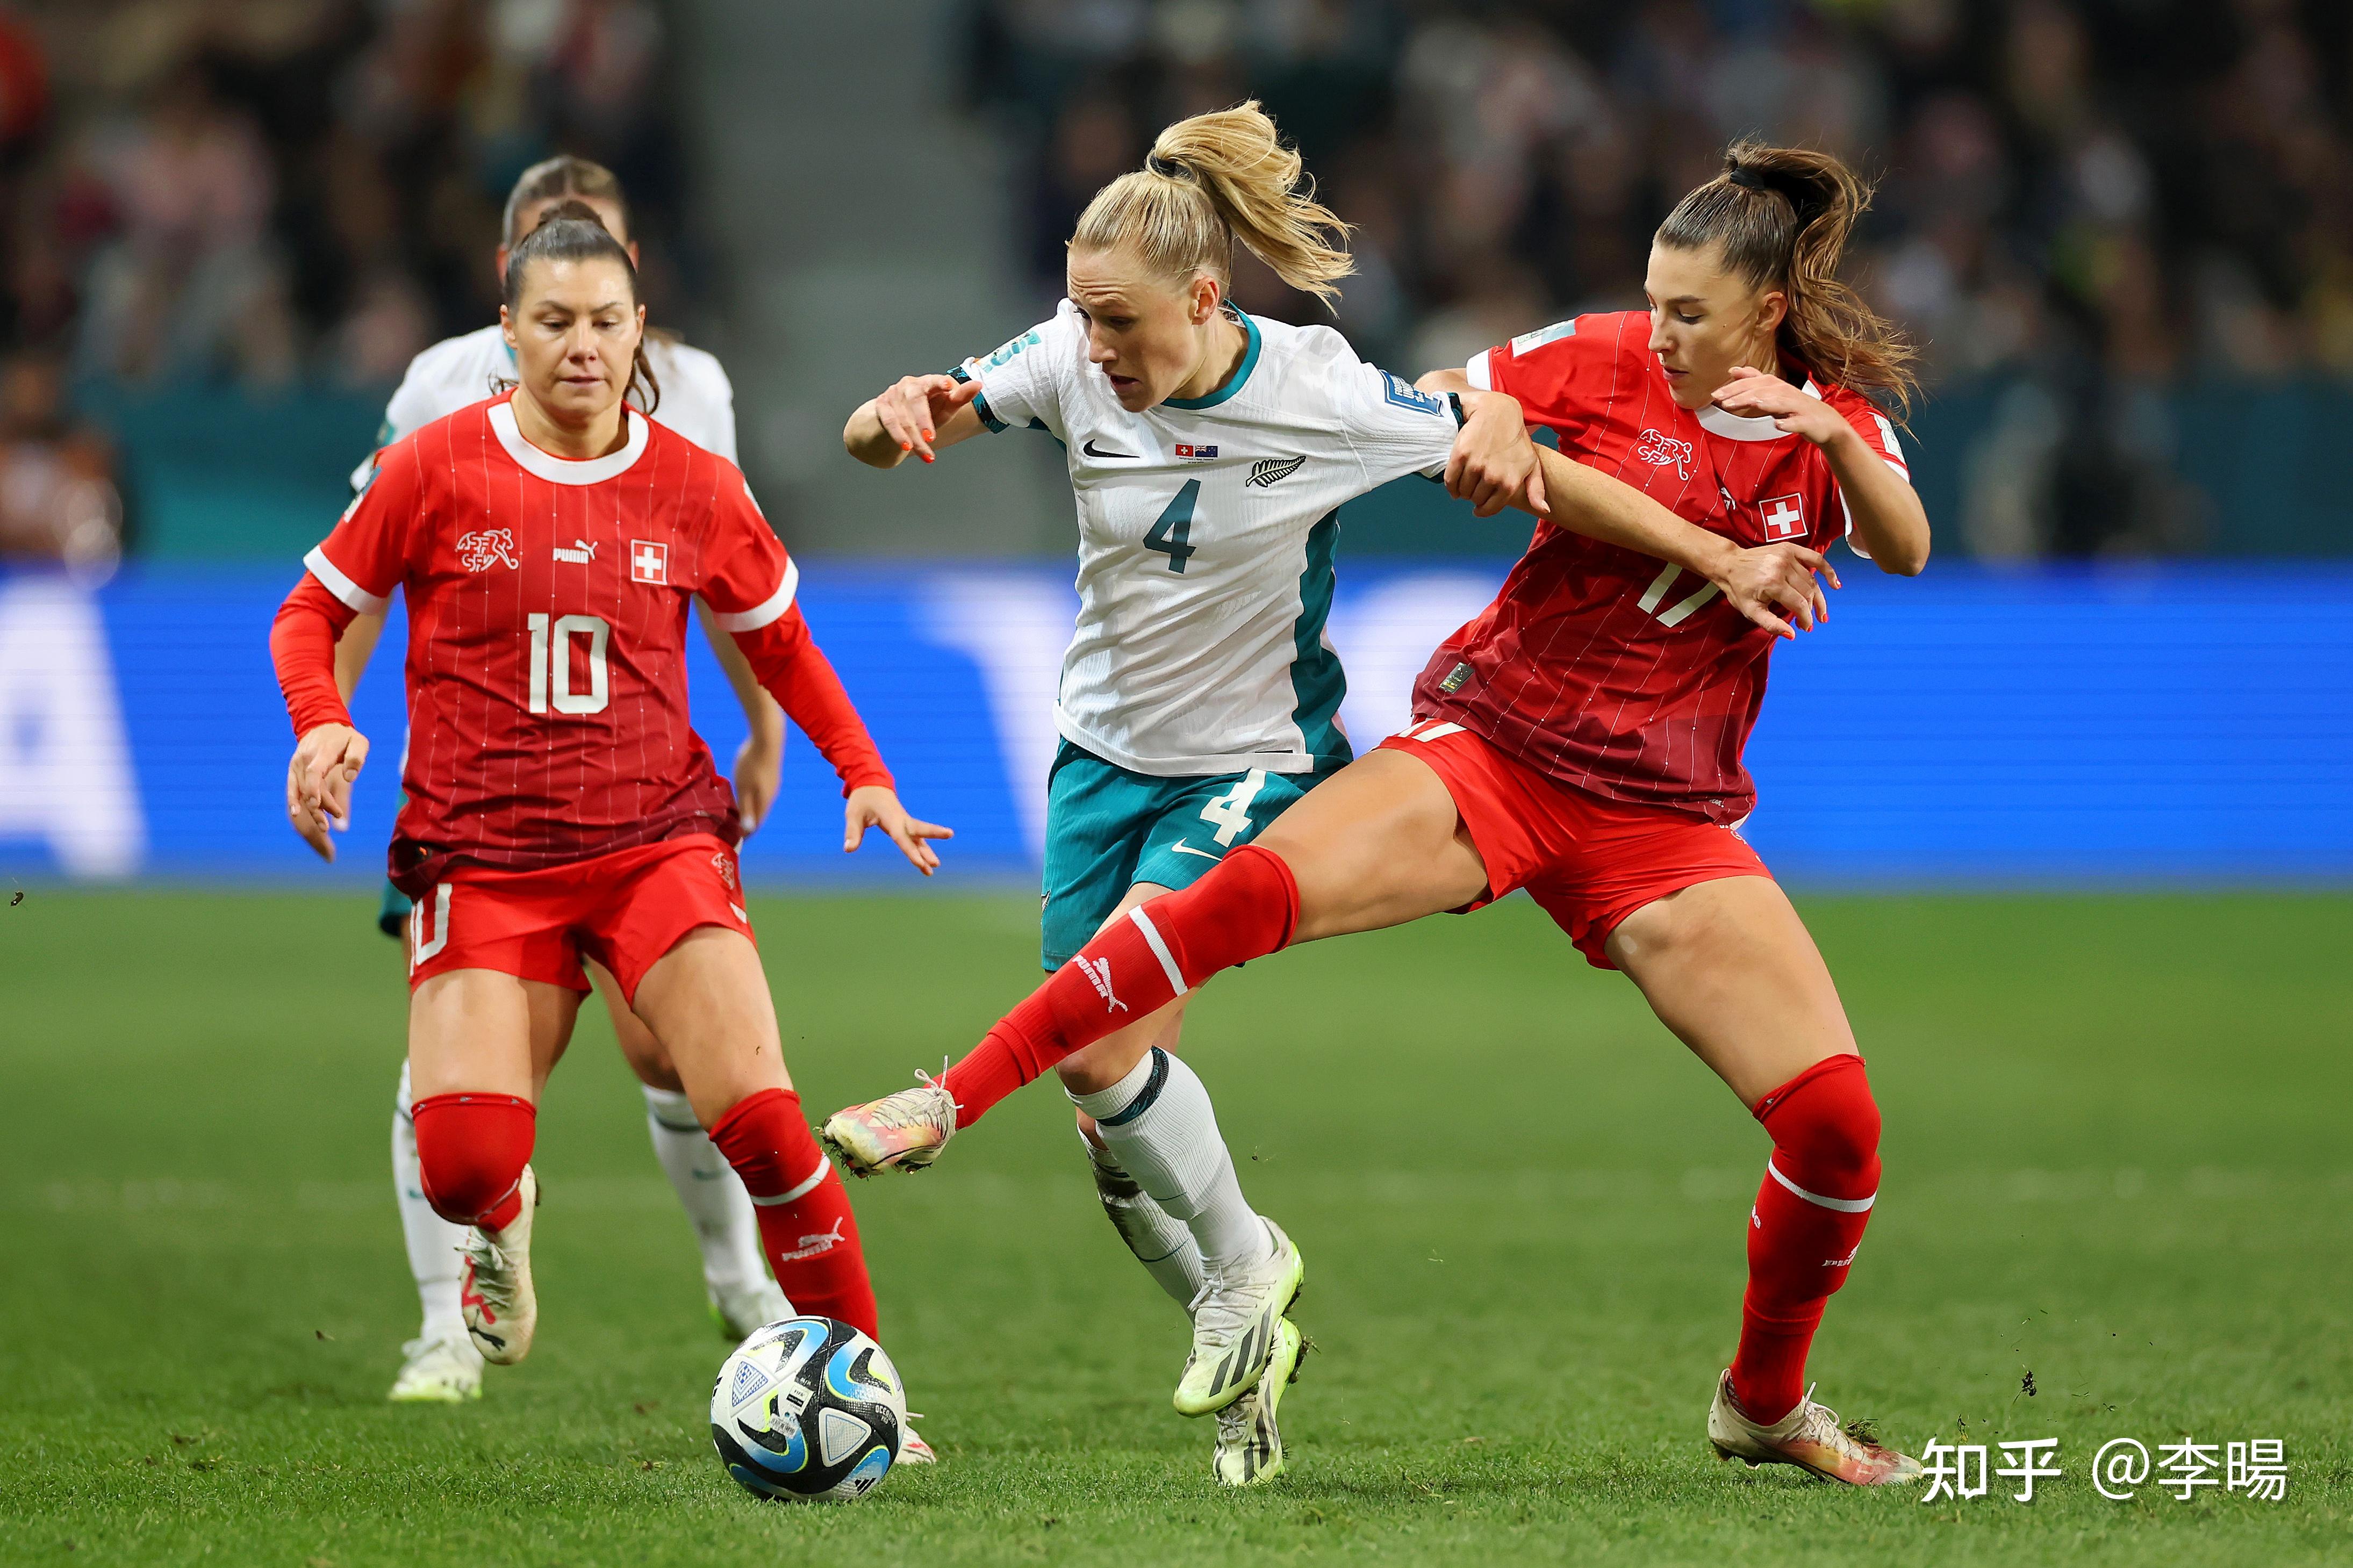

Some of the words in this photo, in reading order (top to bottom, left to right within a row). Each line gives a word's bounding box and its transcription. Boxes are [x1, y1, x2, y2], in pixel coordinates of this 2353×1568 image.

[553, 547, 589, 564] PUMA
[1143, 478, 1201, 574] 4
[527, 613, 610, 714] 10
[1199, 767, 1267, 848] 4
[1072, 954, 1109, 999] PUMA
